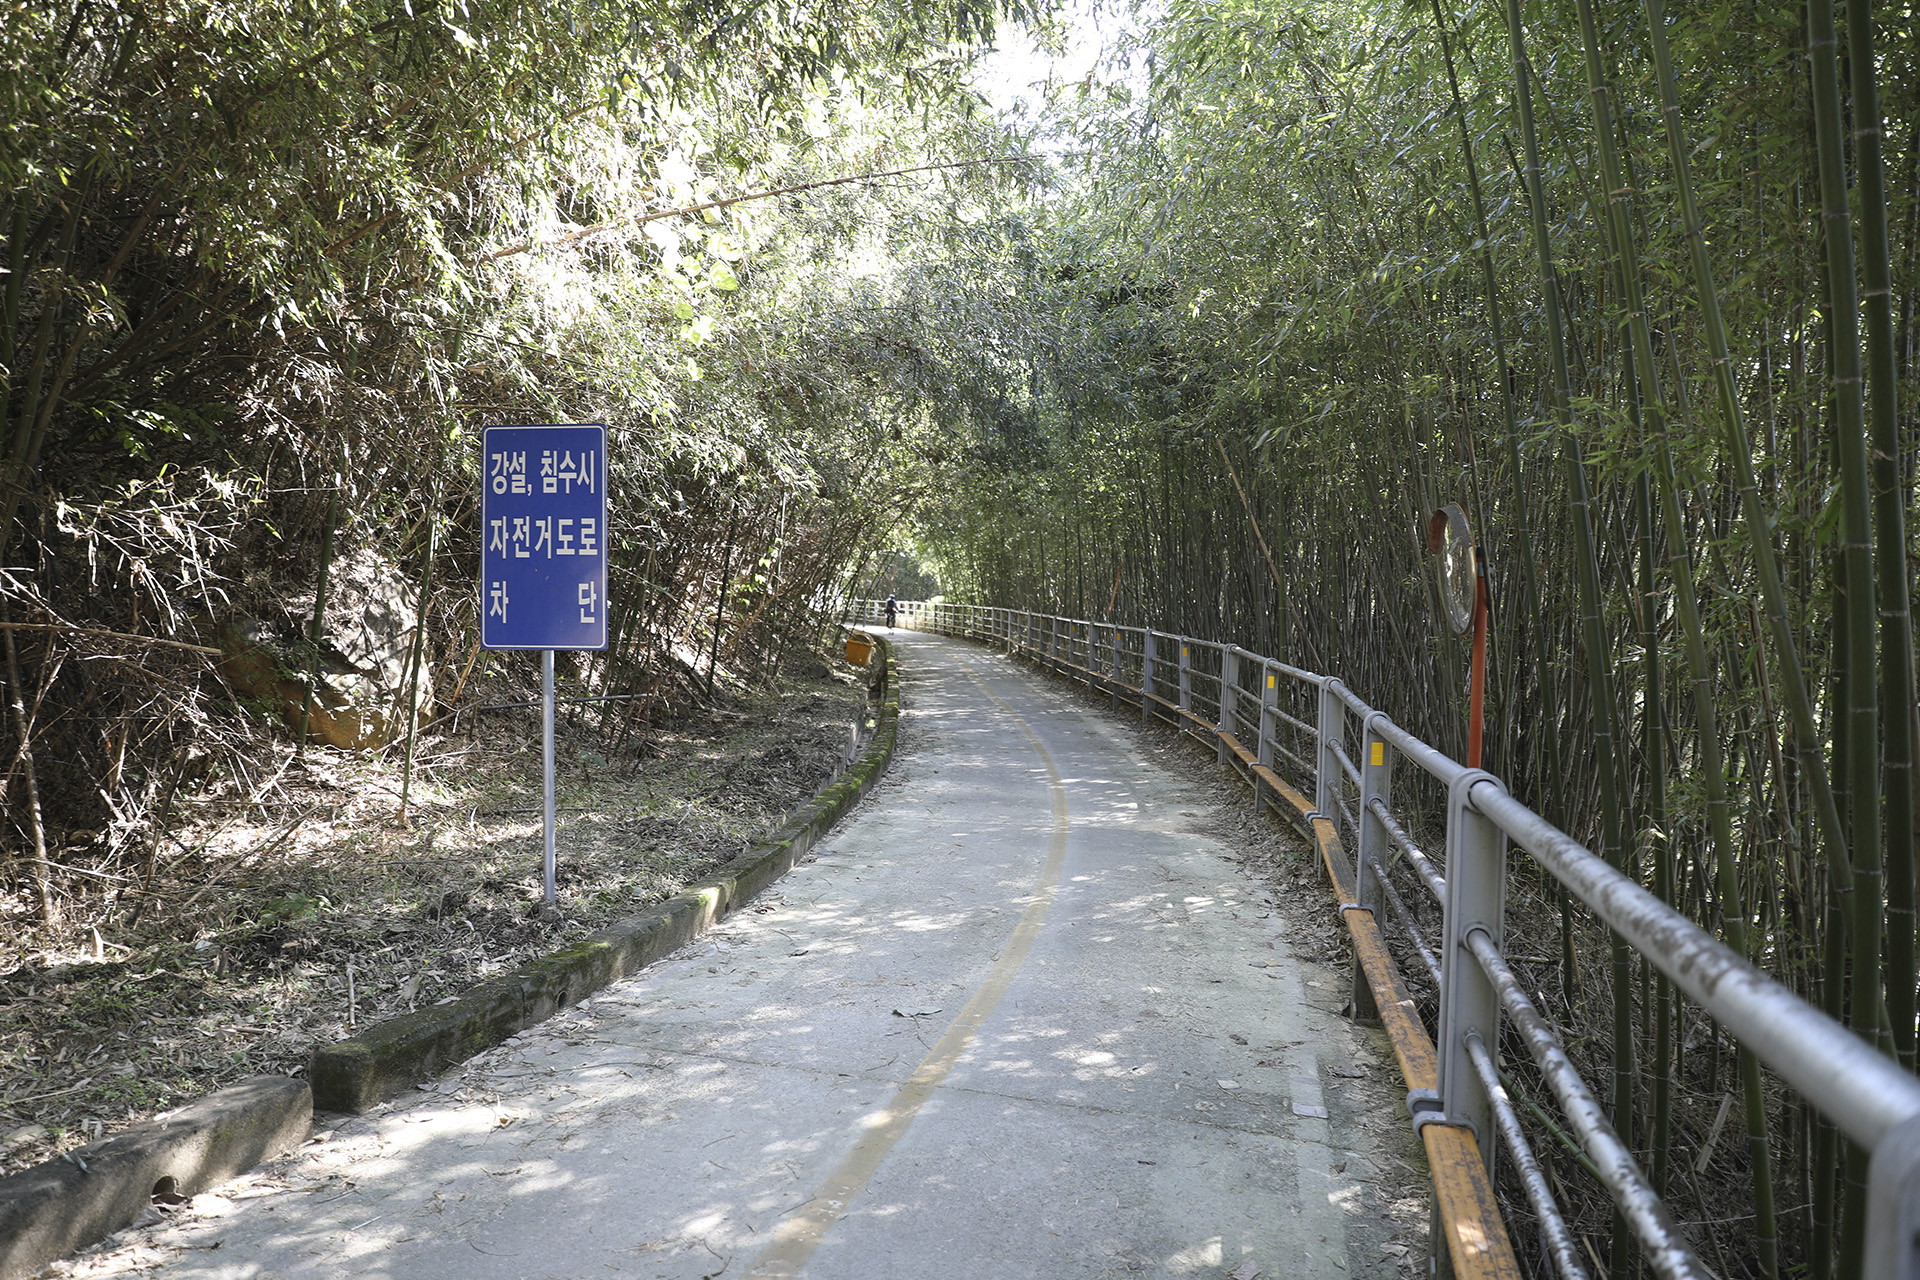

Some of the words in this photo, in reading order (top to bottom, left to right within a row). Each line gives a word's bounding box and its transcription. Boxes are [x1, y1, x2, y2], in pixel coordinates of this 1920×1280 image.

[490, 450, 533, 497] 강설,
[540, 450, 595, 494] 침수시
[489, 516, 598, 559] 자전거도로
